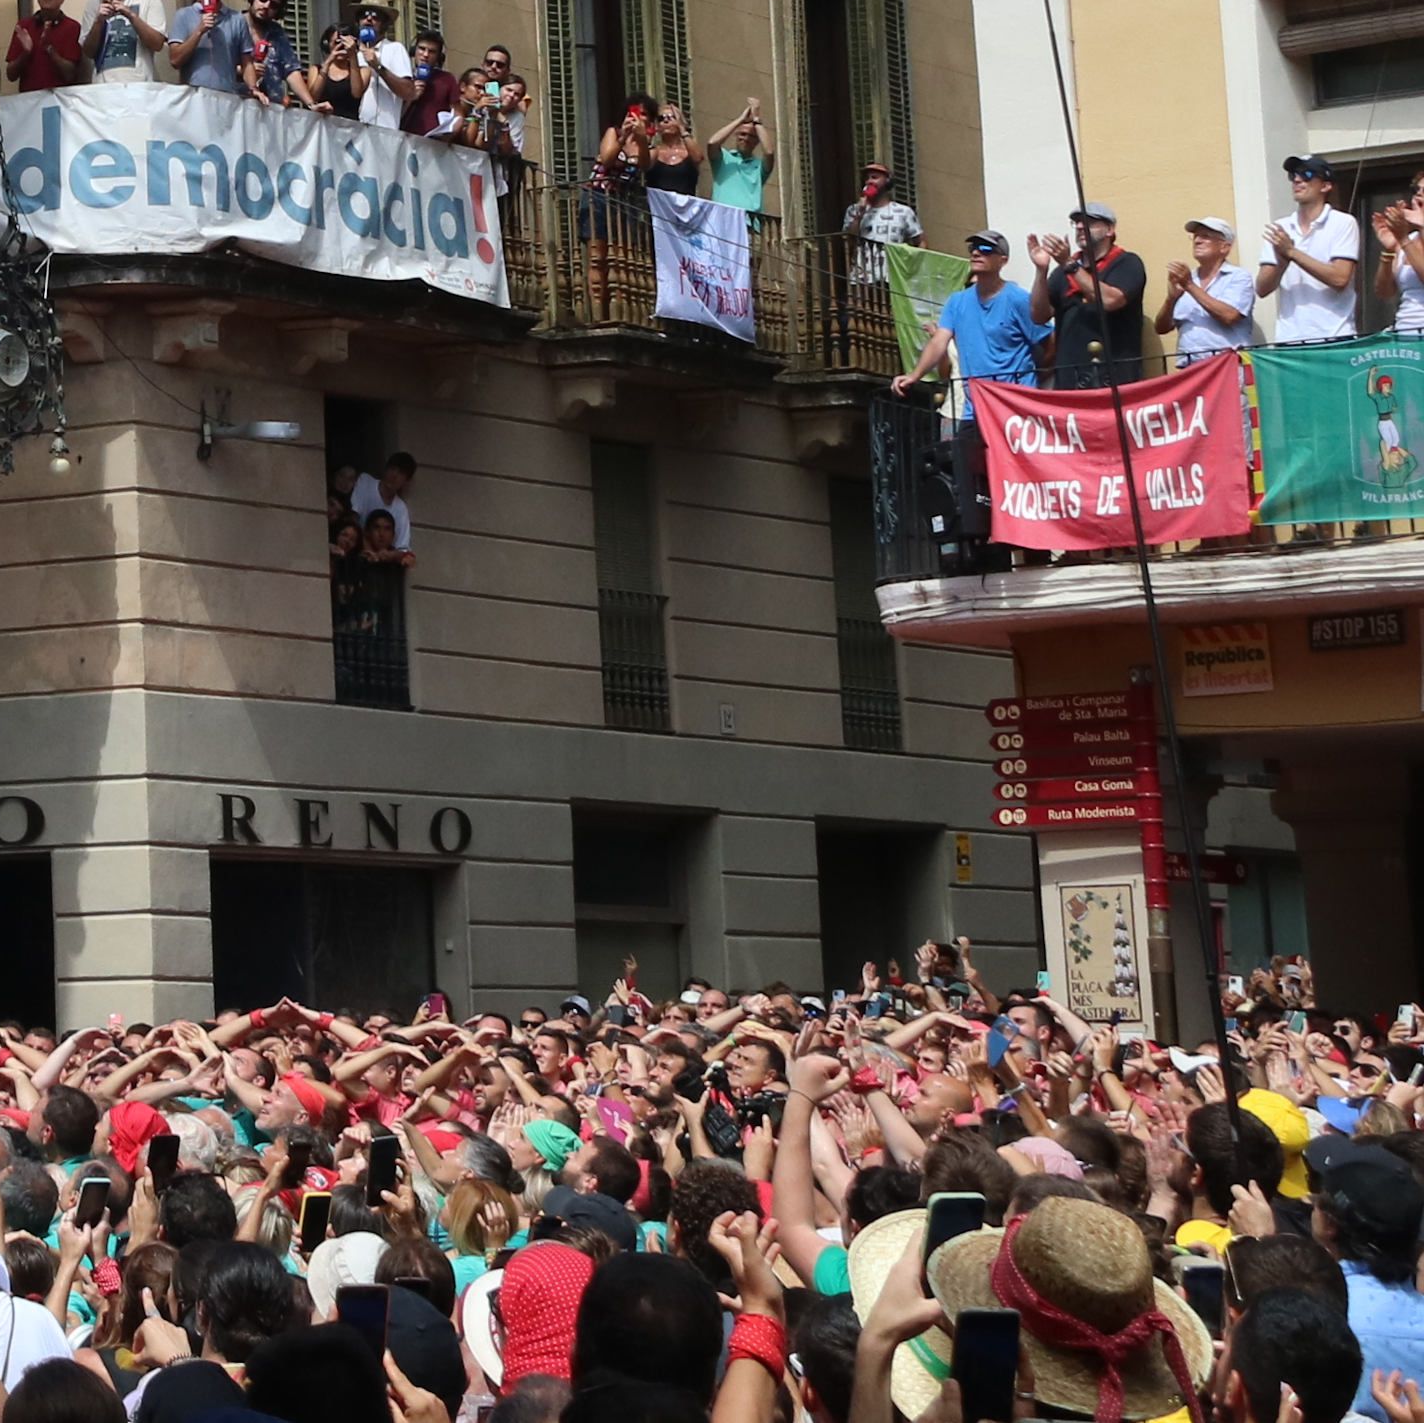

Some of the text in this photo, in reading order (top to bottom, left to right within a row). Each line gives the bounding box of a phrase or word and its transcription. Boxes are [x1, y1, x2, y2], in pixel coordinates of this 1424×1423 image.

[3, 106, 495, 264] democràcia!
[1350, 348, 1422, 366] CASTELLERS
[1005, 396, 1209, 454] COLLA VELLA
[1000, 463, 1205, 521] XIQUETS DE VALLS
[1362, 490, 1424, 504] VILAFRANC
[1312, 616, 1365, 641] #STOP
[1368, 612, 1399, 637] 155
[1072, 694, 1126, 709] Campanar
[1058, 710, 1073, 721] de
[1075, 708, 1094, 720] Sta.
[1073, 732, 1101, 743] Palau
[1088, 755, 1133, 767] Vinseum
[1074, 780, 1099, 793] Casa
[1047, 805, 1136, 821] Ruta Modernista
[216, 792, 474, 855] RENO
[1070, 969, 1084, 980] LA
